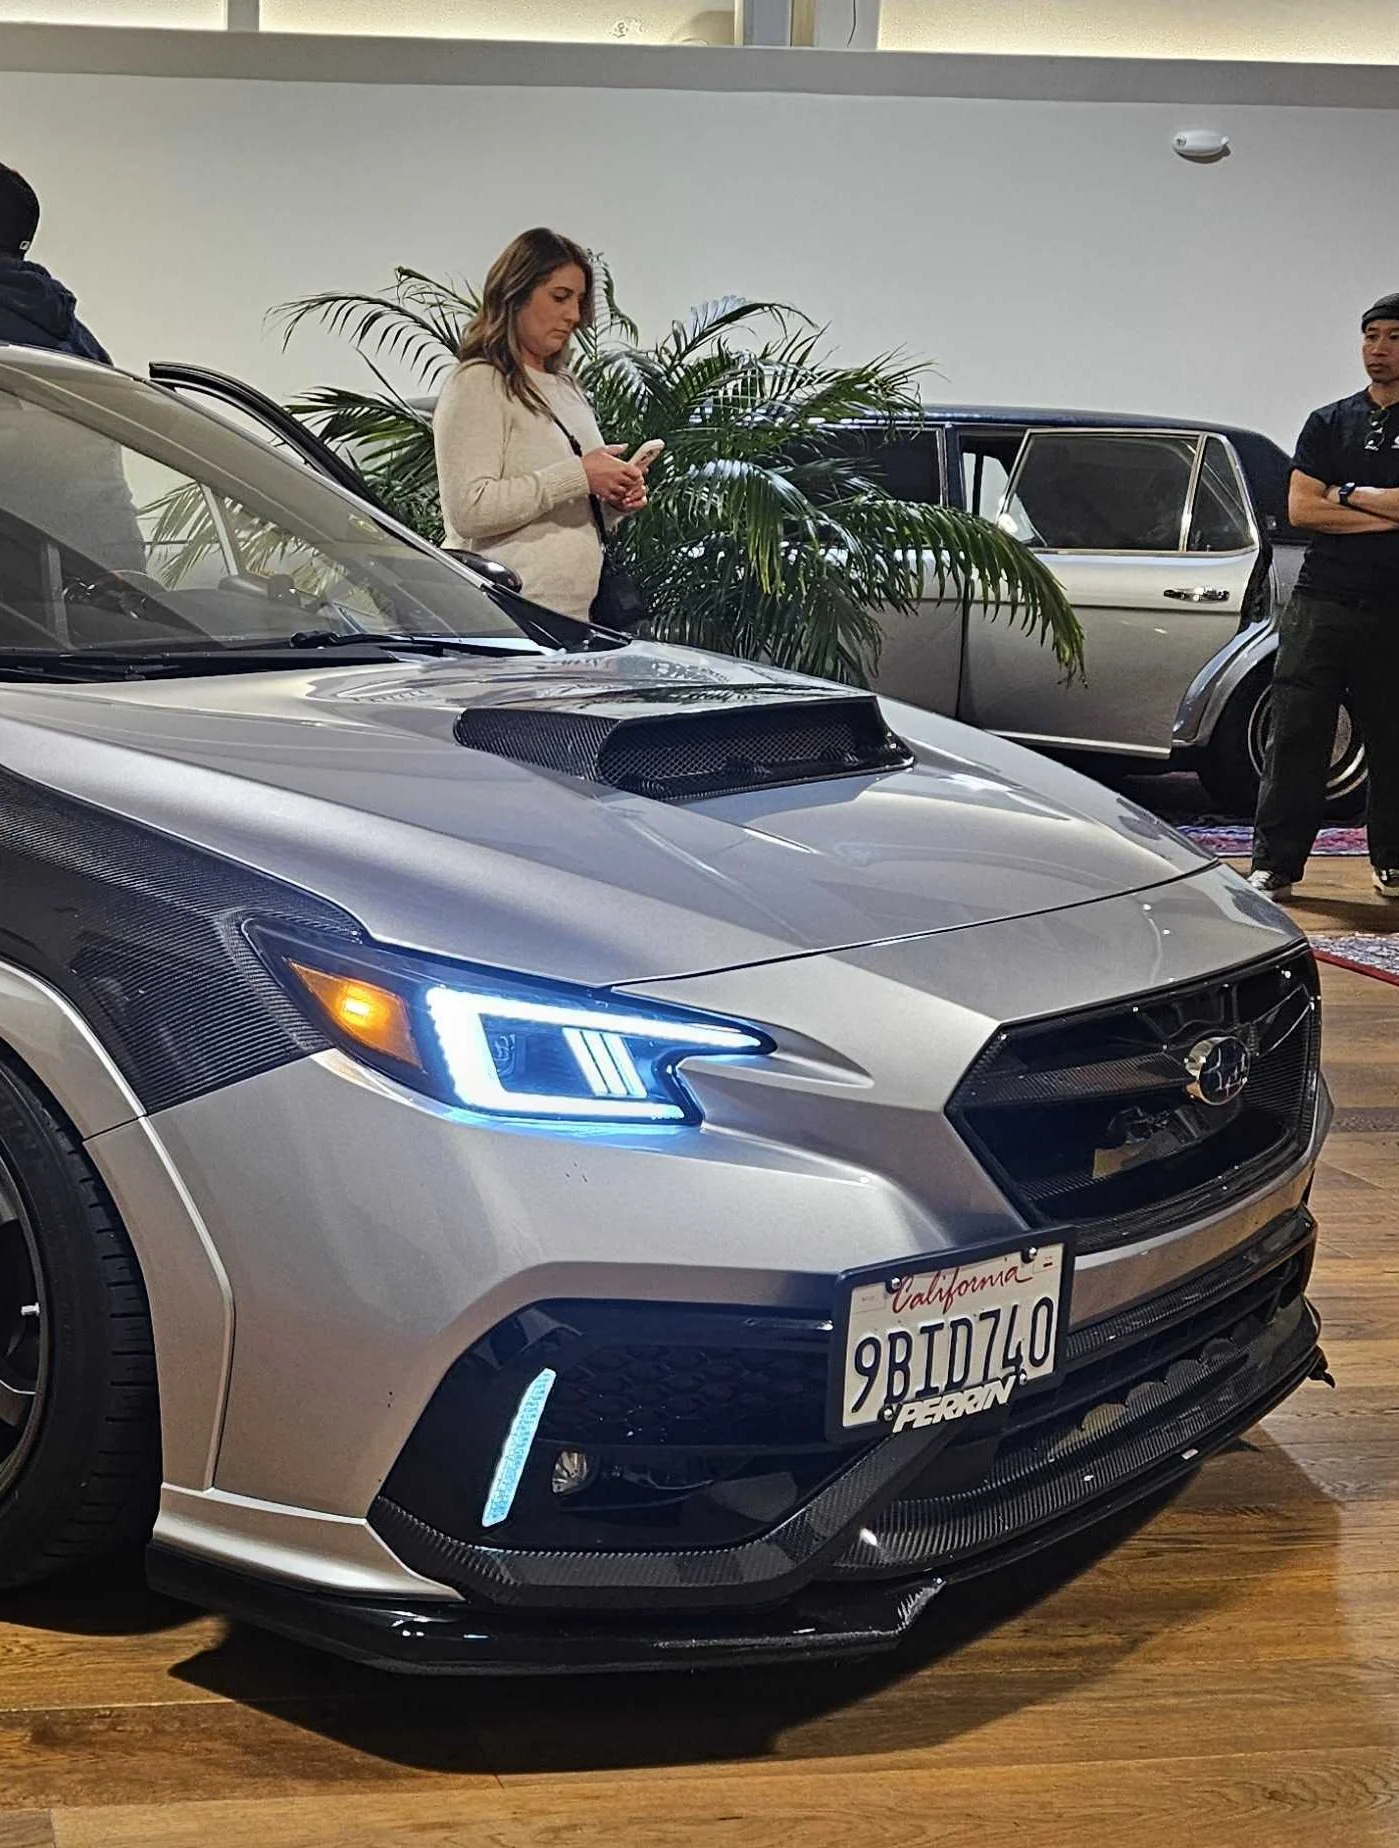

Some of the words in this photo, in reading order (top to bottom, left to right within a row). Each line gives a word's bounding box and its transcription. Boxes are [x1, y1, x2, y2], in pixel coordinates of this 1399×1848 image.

[891, 1258, 1034, 1315] California
[852, 1296, 1055, 1414] 9BID740
[892, 1375, 1017, 1434] PERRIN
